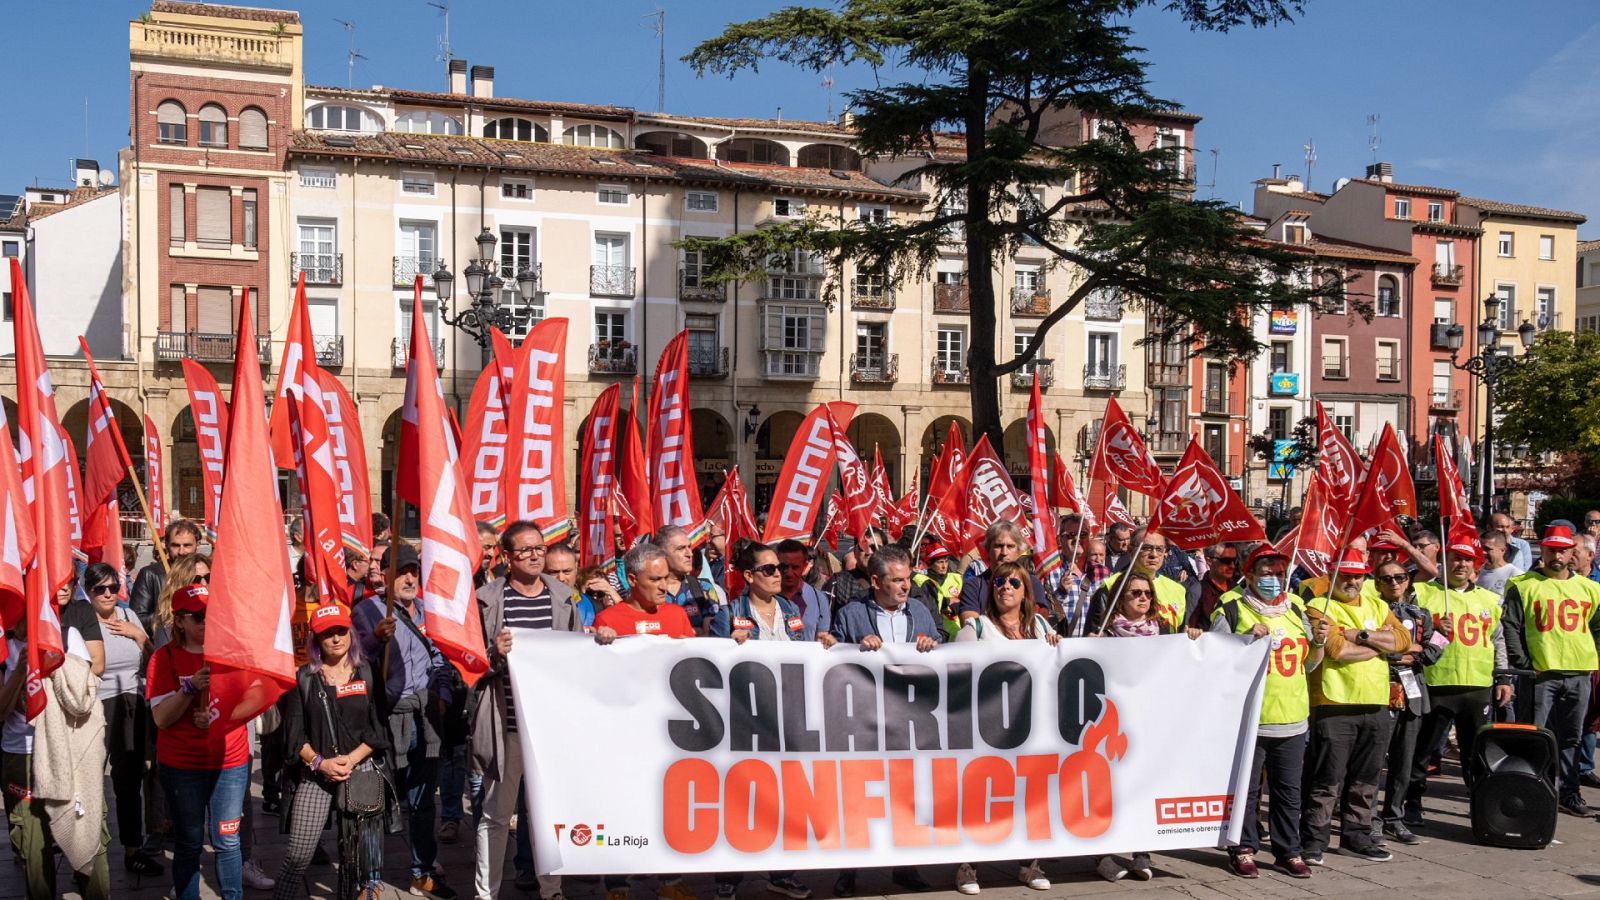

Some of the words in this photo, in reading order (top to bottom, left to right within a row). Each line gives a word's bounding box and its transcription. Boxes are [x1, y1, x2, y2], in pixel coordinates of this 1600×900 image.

[518, 349, 558, 521] CCOO
[779, 416, 833, 532] CCOO
[973, 462, 1018, 515] UGT
[1533, 599, 1592, 633] UGT
[1267, 637, 1308, 678] GT
[338, 683, 365, 693] CCOO
[668, 656, 1032, 752] SALARIO
[1058, 658, 1106, 746] O
[663, 751, 1113, 854] CONFLICTO
[1160, 800, 1224, 819] CCOO
[608, 836, 620, 846] La
[623, 836, 649, 848] Rioja
[1157, 826, 1195, 834] comisiones
